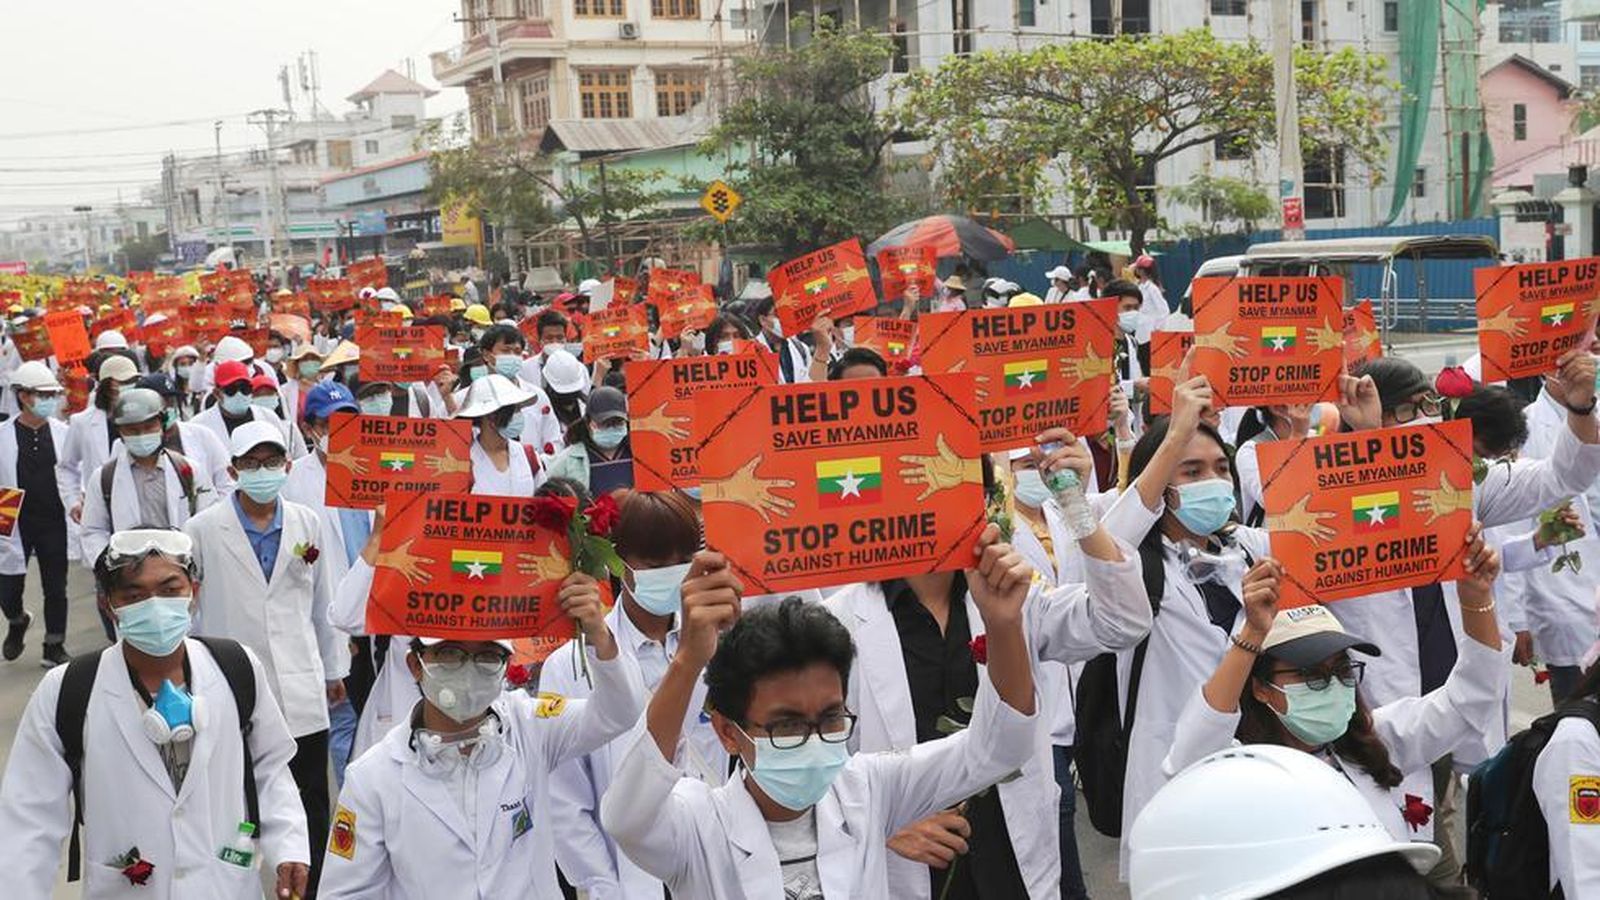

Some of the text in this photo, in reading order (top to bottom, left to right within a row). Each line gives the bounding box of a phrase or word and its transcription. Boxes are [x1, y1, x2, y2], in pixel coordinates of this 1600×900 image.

[785, 250, 836, 277] HELP US
[1519, 263, 1598, 288] HELP US
[1238, 283, 1318, 303] HELP US
[1519, 283, 1595, 301] SAVE MYANMAR
[615, 309, 628, 317] US
[794, 304, 817, 319] STOP
[821, 290, 855, 308] CRIME
[1239, 306, 1317, 318] SAVE MYANMAR
[380, 328, 425, 338] HELP US
[876, 320, 902, 331] HELP
[972, 309, 1076, 338] HELP US
[974, 334, 1075, 354] SAVE MYANMAR
[1510, 340, 1549, 359] STOP
[673, 359, 758, 384] HELP US
[1510, 355, 1548, 369] AGAINST
[1229, 364, 1321, 383] STOP CRIME
[1227, 382, 1321, 396] AGAINST HUMANITY
[770, 386, 917, 426] HELP US
[979, 396, 1080, 427] TOP CRIME
[361, 419, 437, 437] HELP US
[773, 421, 919, 449] SAVE MYANMAR
[980, 425, 1019, 441] AINST
[361, 436, 436, 447] SAVE MYANMAR
[1314, 433, 1426, 469] HELP US
[670, 447, 700, 465] ST
[1317, 462, 1427, 488] SAVE MYANMAR
[351, 480, 441, 493] STOP CRIME
[425, 498, 537, 526] HELP US
[423, 524, 536, 541] SAVE MYANMAR
[763, 512, 937, 555] STOP CRIME
[763, 540, 938, 576] AGAINST HUMANITY
[1314, 535, 1438, 573] STOP CRIME
[1315, 557, 1439, 589] AGAINST HUMANITY
[406, 591, 541, 613] STOP CRIME
[405, 612, 538, 628] AGAINST HUMANITY
